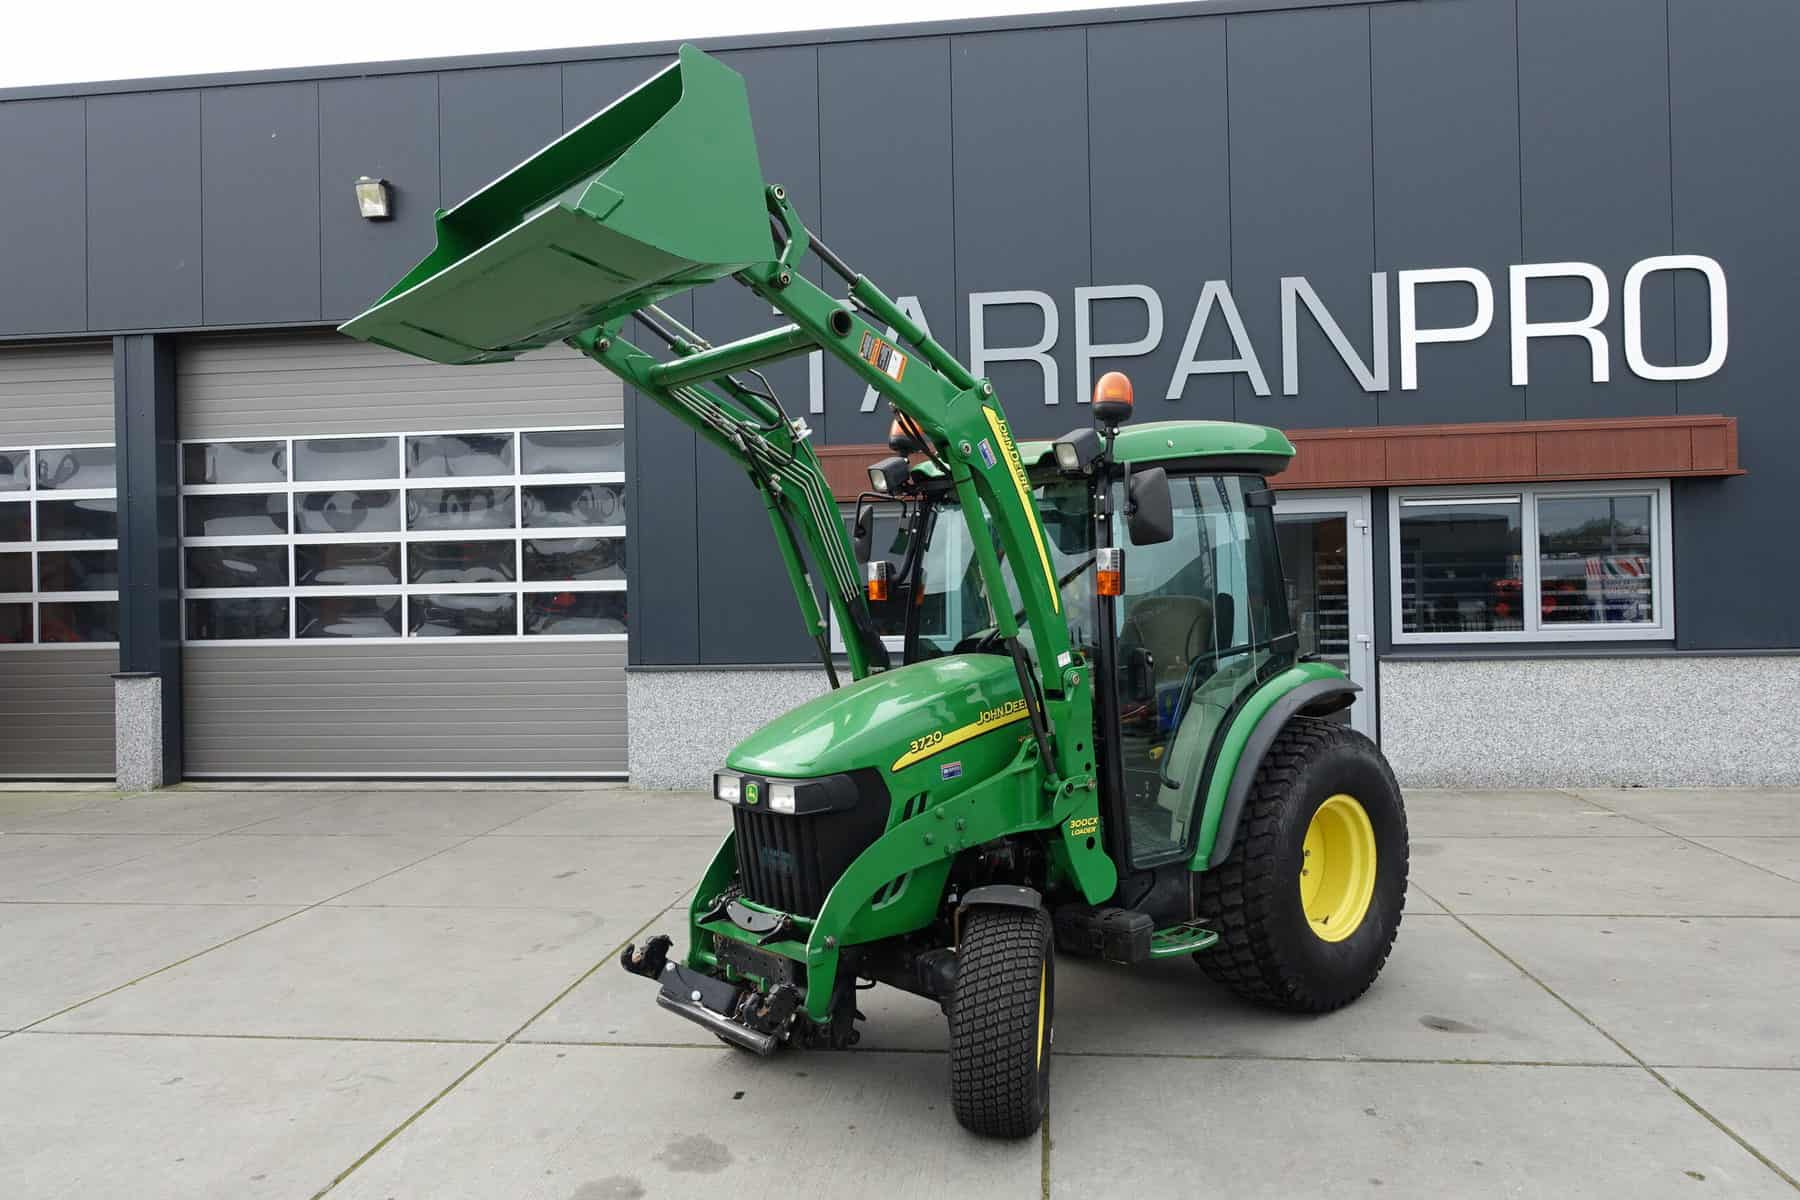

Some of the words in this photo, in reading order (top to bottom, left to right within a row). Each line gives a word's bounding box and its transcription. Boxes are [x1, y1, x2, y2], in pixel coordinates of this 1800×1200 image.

[997, 418, 1015, 451] JOHN
[976, 704, 1004, 726] JOHN
[1003, 698, 1028, 715] DEE
[909, 730, 943, 753] 3720
